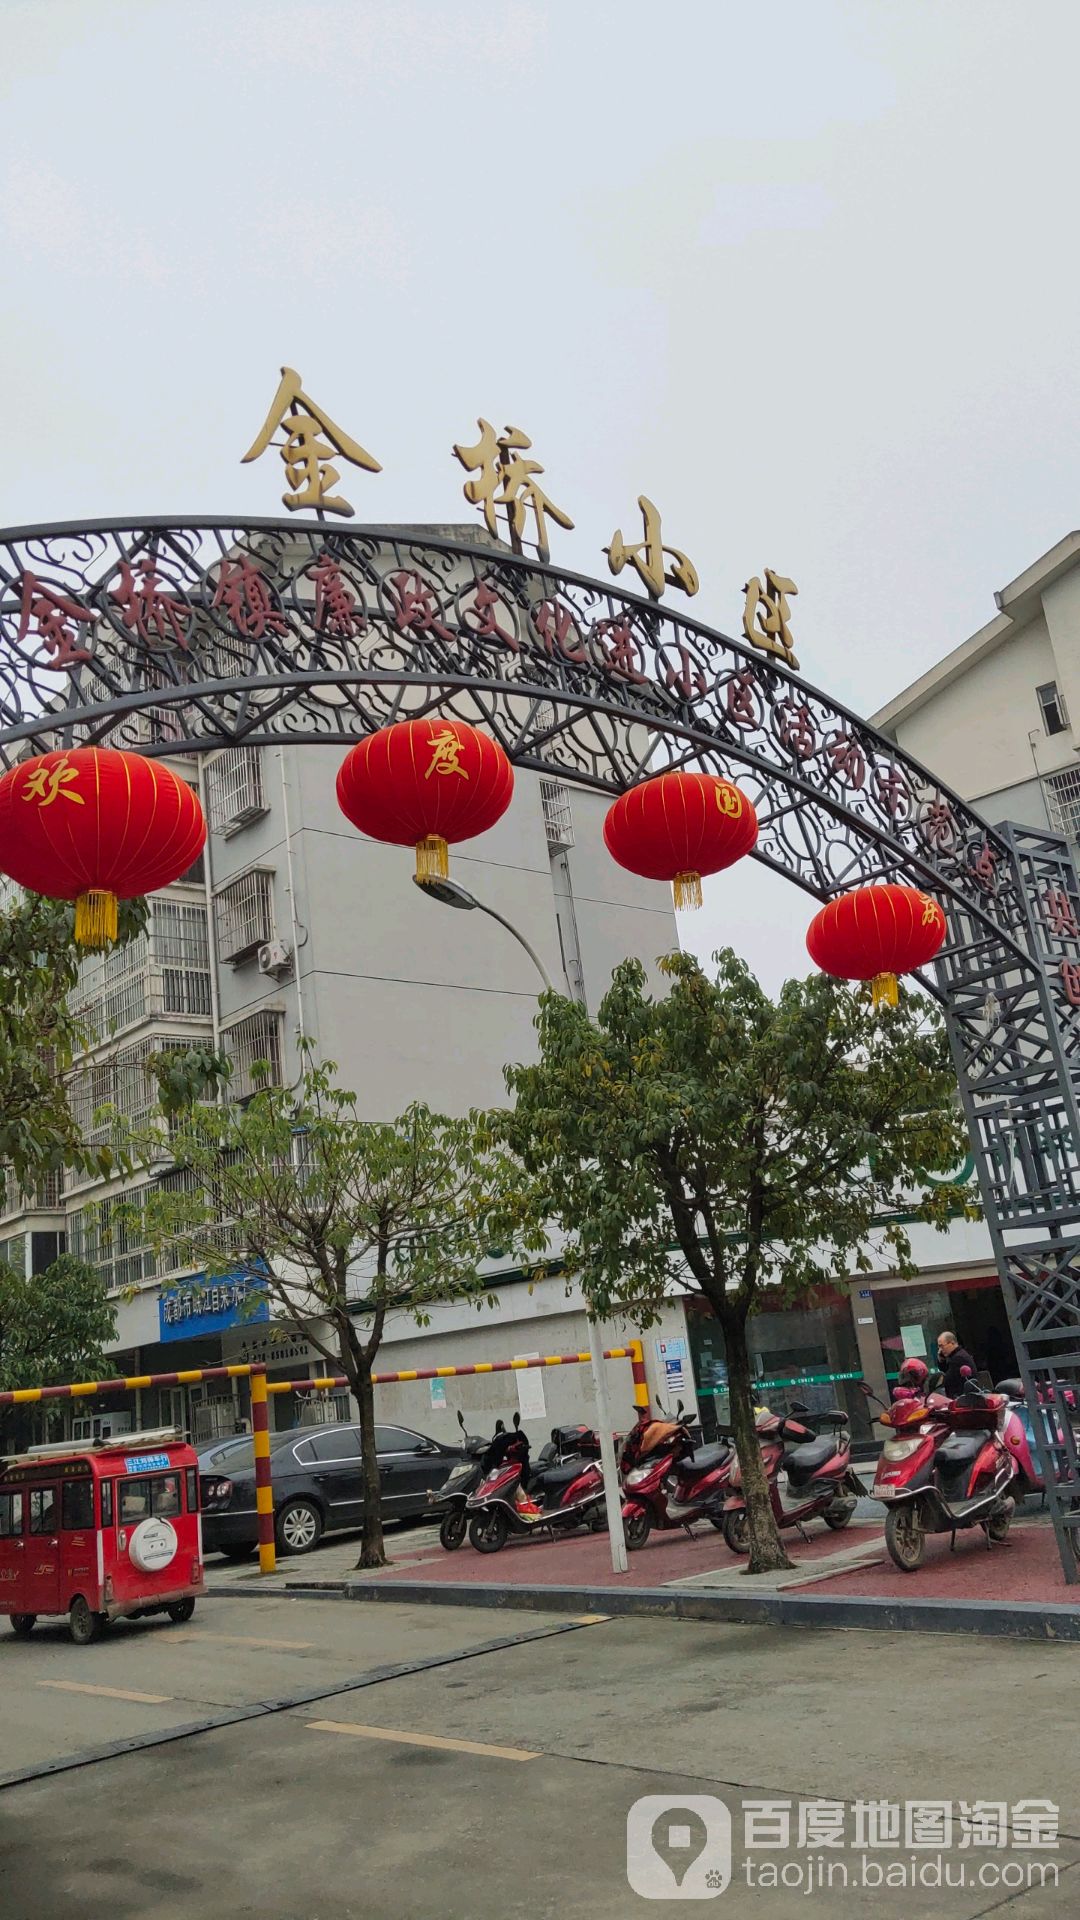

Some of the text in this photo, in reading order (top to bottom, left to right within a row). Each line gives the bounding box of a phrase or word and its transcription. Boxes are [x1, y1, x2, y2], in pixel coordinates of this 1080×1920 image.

[241, 366, 800, 670] 金桥小区
[424, 729, 469, 780] 度
[22, 757, 86, 807] 欢
